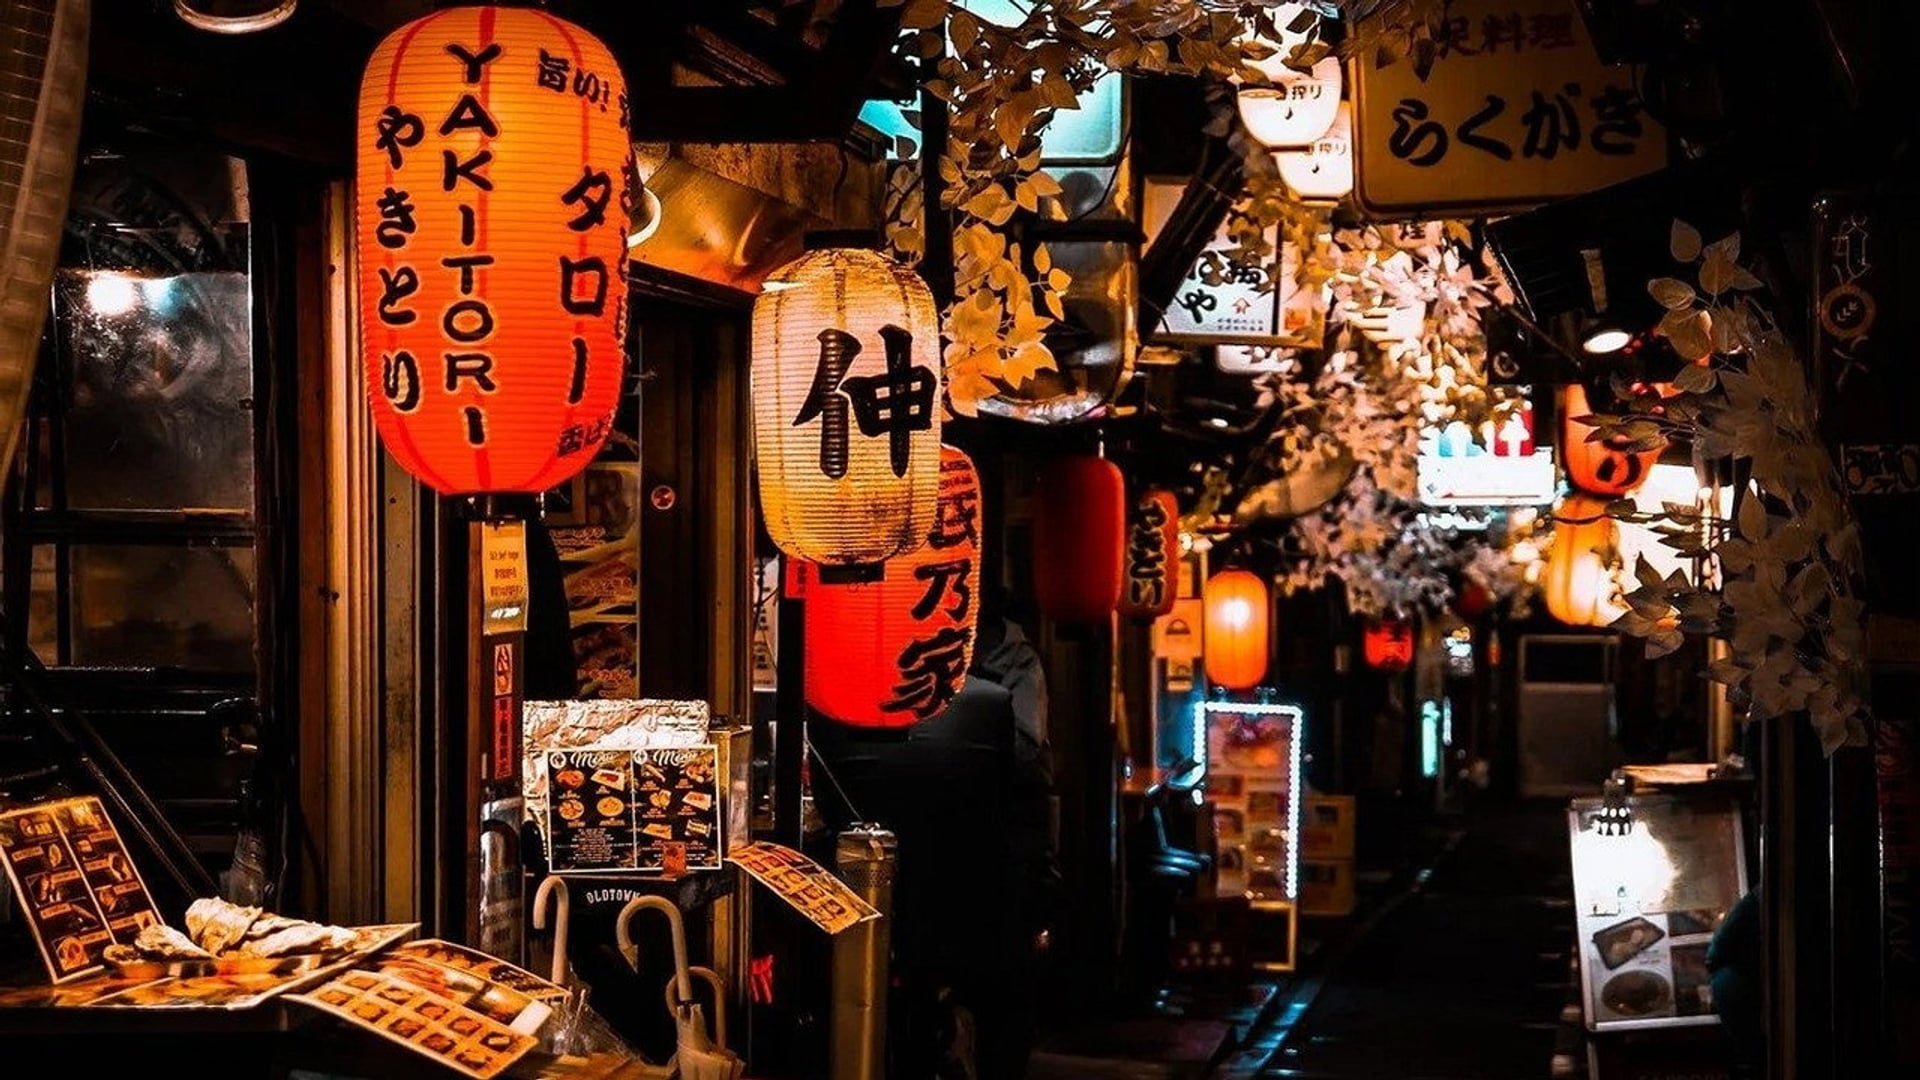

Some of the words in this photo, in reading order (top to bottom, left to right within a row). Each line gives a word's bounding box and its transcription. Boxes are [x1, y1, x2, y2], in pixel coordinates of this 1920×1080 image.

[1389, 83, 1643, 167] らくがき
[376, 106, 424, 411] やきとり
[439, 44, 502, 446] YAKITORI
[560, 165, 612, 404] タロー
[792, 323, 937, 479] 伸
